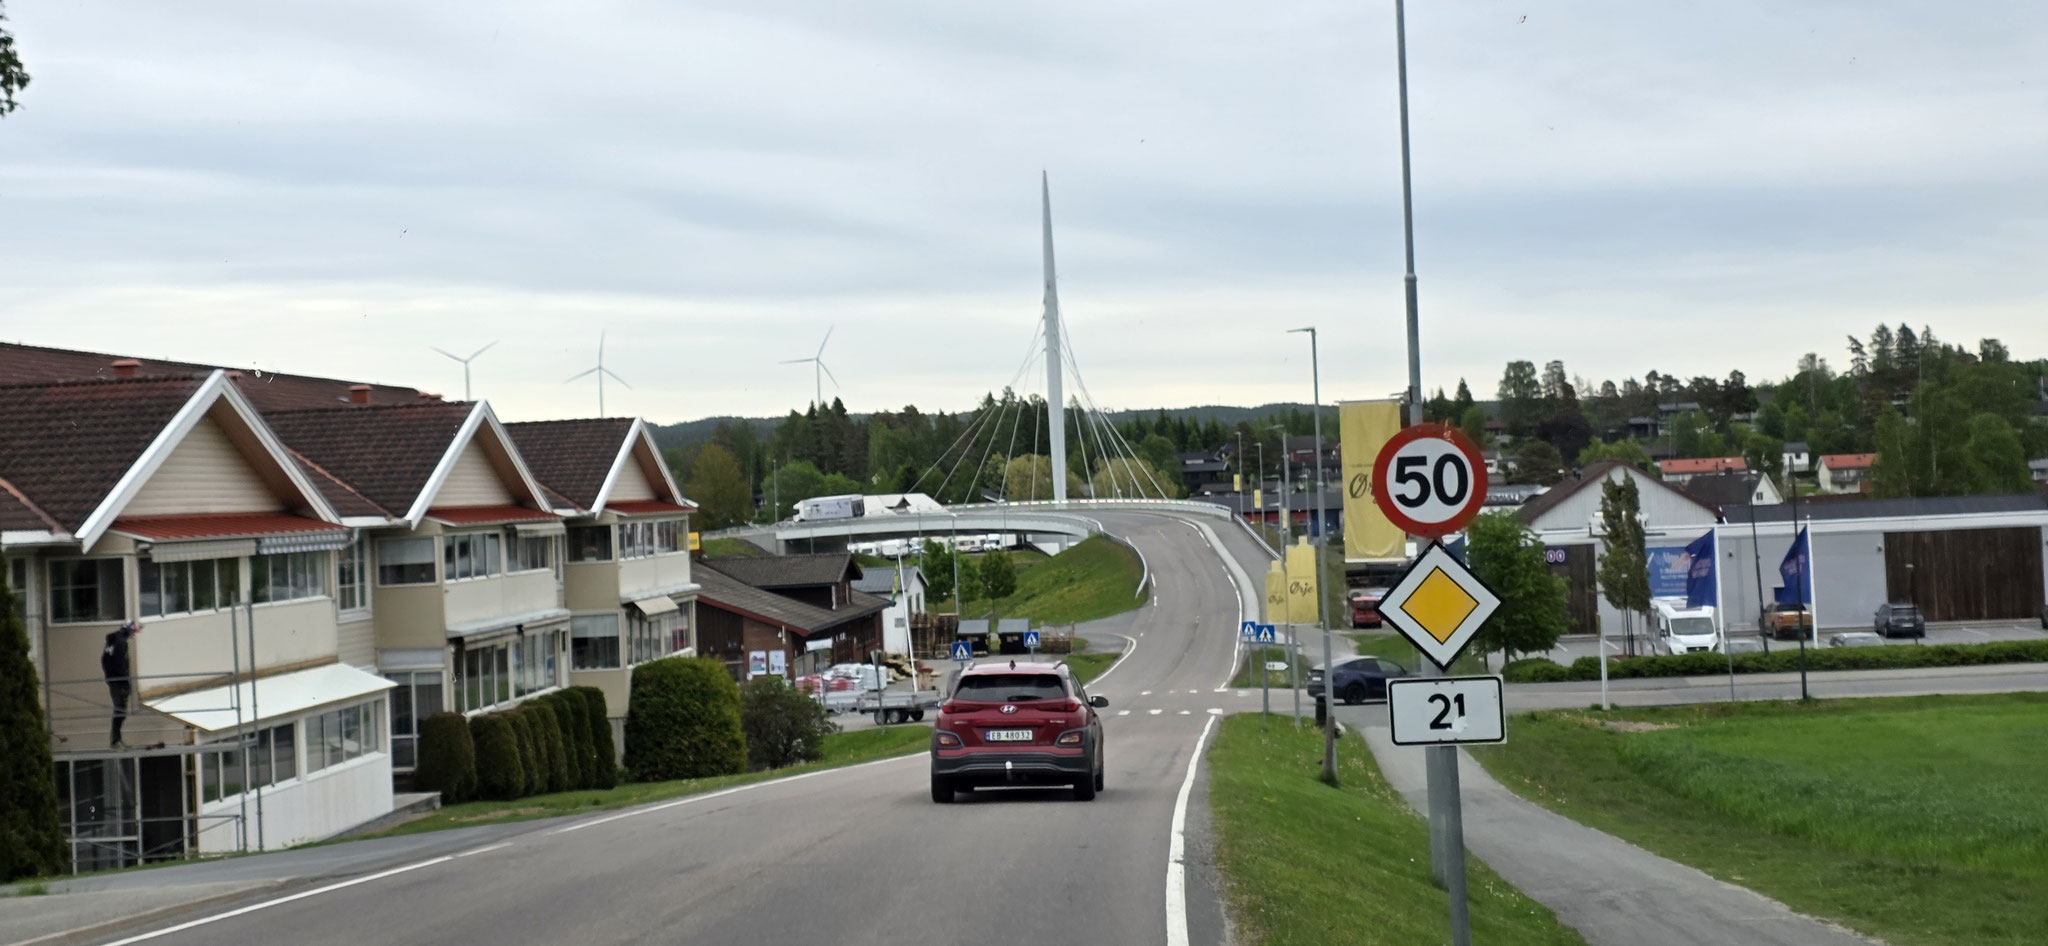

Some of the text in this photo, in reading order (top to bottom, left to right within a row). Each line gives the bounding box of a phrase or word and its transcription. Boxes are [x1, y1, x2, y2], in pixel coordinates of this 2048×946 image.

[1395, 453, 1468, 508] 50
[1289, 580, 1313, 597] Ørje
[1428, 693, 1466, 730] 21
[991, 731, 1030, 740] EB 48032
